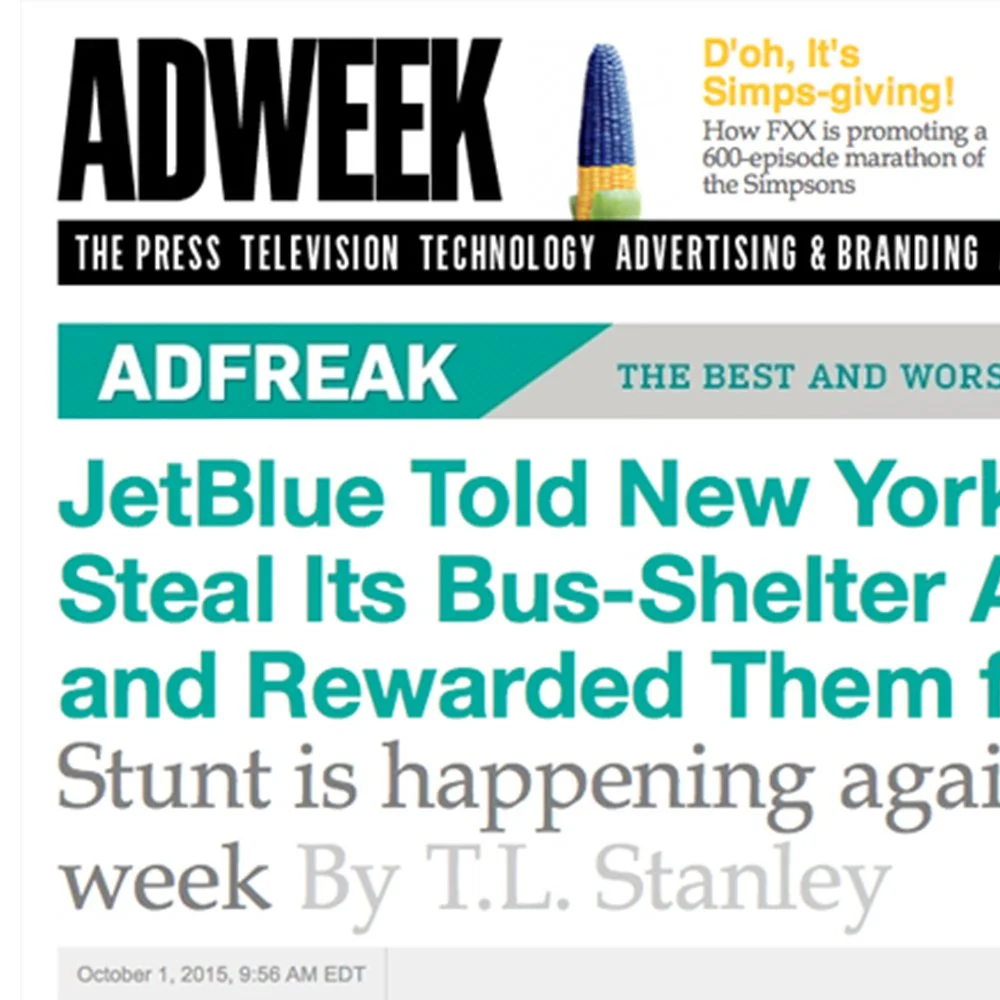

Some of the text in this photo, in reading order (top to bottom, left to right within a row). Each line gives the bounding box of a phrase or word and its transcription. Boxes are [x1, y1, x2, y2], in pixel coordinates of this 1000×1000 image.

[704, 37, 860, 73] D'oh, It's
[703, 75, 953, 114] Simps-giving!
[57, 38, 503, 202] ADWEEK
[703, 119, 988, 144] How FXX is promoting a
[702, 145, 986, 171] 600-episode marathon of
[703, 171, 856, 202] the Simpsons
[75, 234, 123, 270] THE
[137, 234, 220, 270] PRESS
[240, 234, 398, 270] TELEVISION
[419, 235, 595, 270] TECHNOLOGY
[616, 234, 796, 270] ADVERTISING
[810, 235, 826, 270] &
[838, 234, 978, 270] BRANDING
[98, 344, 458, 401] ADFREAK
[617, 363, 690, 389] THE
[703, 363, 795, 390] BEST
[808, 363, 886, 390] AND
[59, 459, 385, 528] JetBlue
[410, 459, 587, 528] Told
[620, 459, 810, 528] New
[59, 553, 273, 624] Steal
[307, 554, 406, 624] Its
[439, 553, 946, 624] Bus-Shelter
[60, 650, 216, 719] and
[249, 650, 683, 719] Rewarded
[711, 650, 952, 719] Them
[58, 742, 272, 809] Stunt
[294, 743, 357, 809] is
[381, 739, 816, 834] happening
[58, 841, 891, 934] week By T.L. Stanley
[77, 966, 366, 984] October 1, 2015, 9:56 AM EDT
